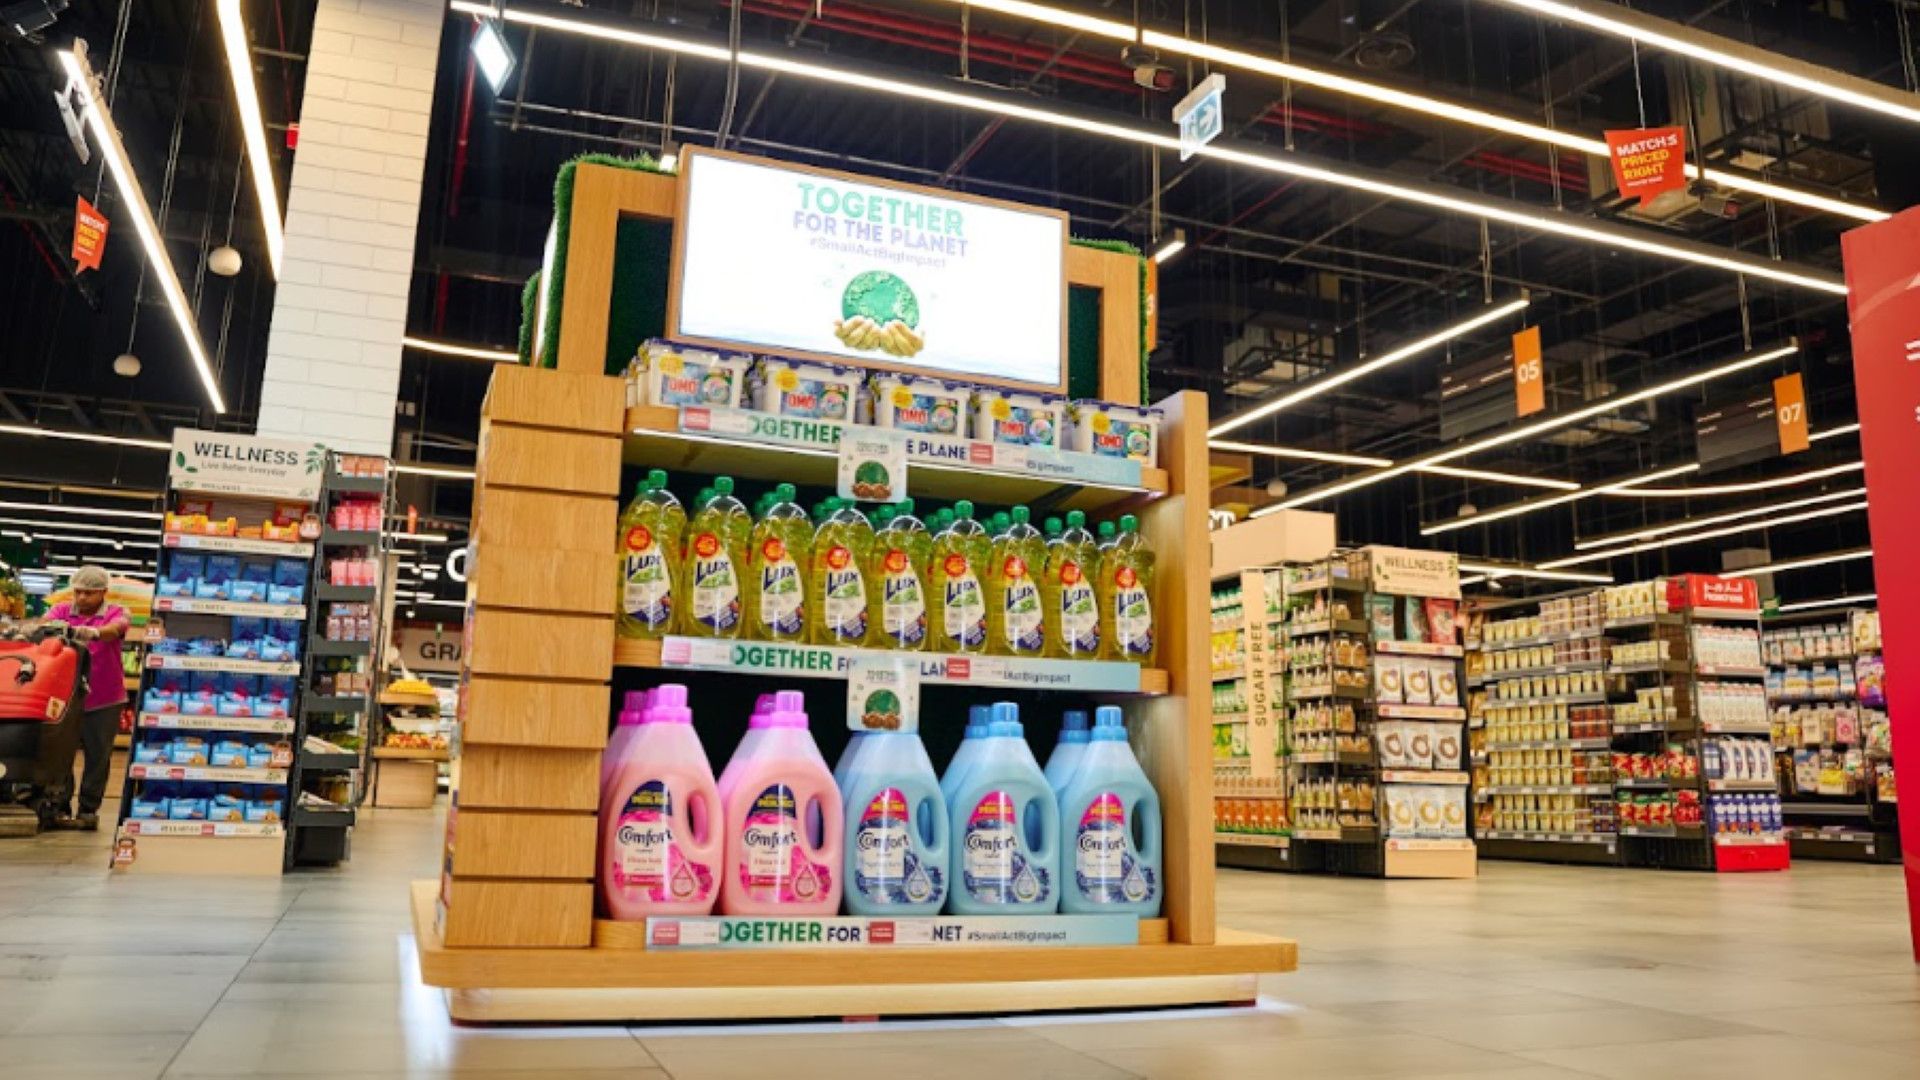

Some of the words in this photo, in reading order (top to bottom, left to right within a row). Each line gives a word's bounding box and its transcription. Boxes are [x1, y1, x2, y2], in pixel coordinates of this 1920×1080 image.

[797, 182, 964, 236] TOGETHER
[793, 211, 837, 236] FOR
[844, 219, 883, 242] THE
[891, 227, 968, 257] PLANET
[1517, 360, 1539, 384] 05
[669, 378, 699, 395] OMO
[788, 393, 816, 410] OMO
[901, 409, 928, 425] OMO
[1780, 402, 1801, 425] 07
[751, 416, 842, 444] OGETHER
[918, 441, 966, 460] PLANE
[1001, 421, 1025, 436] OMO
[1100, 434, 1123, 449] OMO
[194, 442, 298, 465] WELLNESS
[1384, 557, 1444, 572] WELLNESS
[1250, 621, 1262, 662] FREE
[735, 644, 832, 670] OGETHER
[1252, 670, 1267, 727] SUGAR
[618, 826, 672, 847] Comfort
[744, 828, 797, 848] Comfort
[859, 832, 909, 851] Comfort
[967, 834, 1017, 851] Comfort
[1080, 835, 1126, 852] Comfort
[720, 921, 822, 942] OGETHER
[827, 927, 860, 942] FOR
[932, 925, 963, 942] NET
